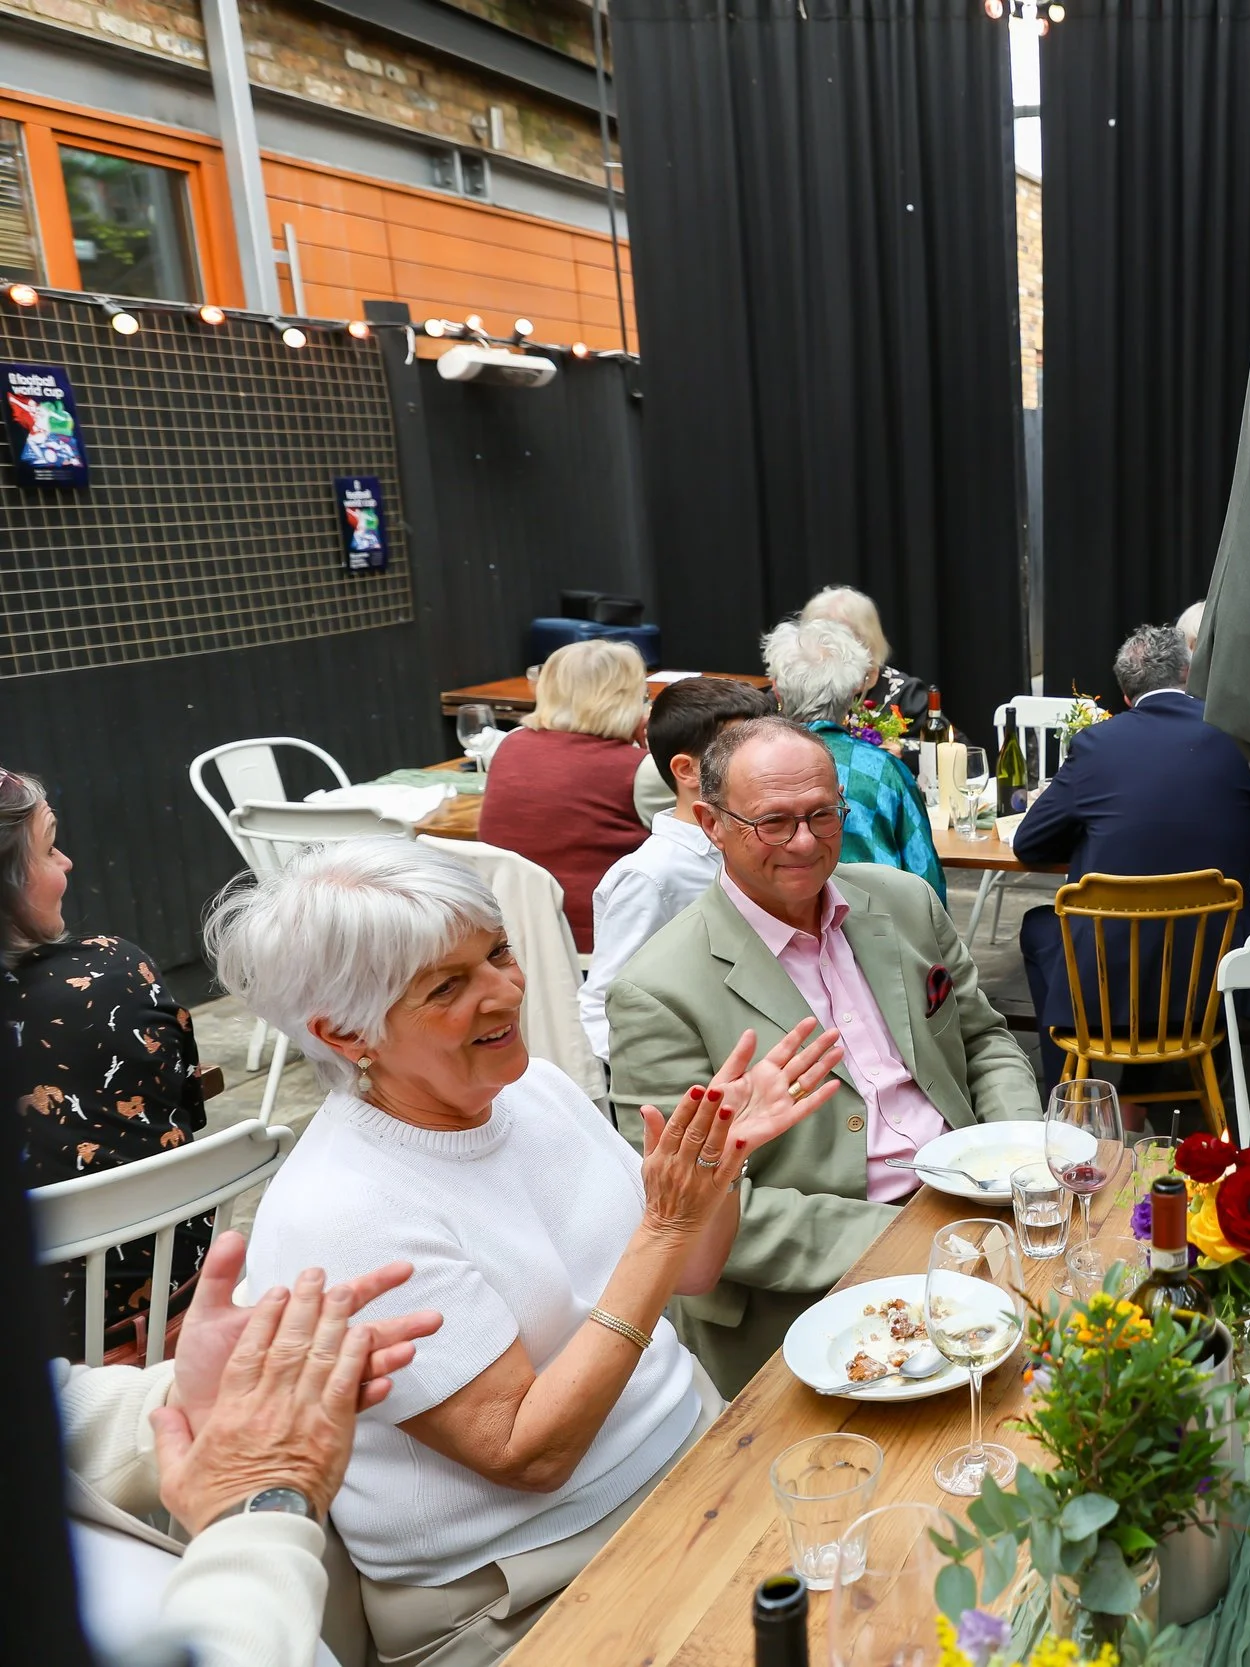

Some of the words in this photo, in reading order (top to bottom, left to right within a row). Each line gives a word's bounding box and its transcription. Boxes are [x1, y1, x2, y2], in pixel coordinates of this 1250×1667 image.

[16, 372, 56, 387] football
[11, 385, 43, 396] world
[43, 387, 64, 399] cup
